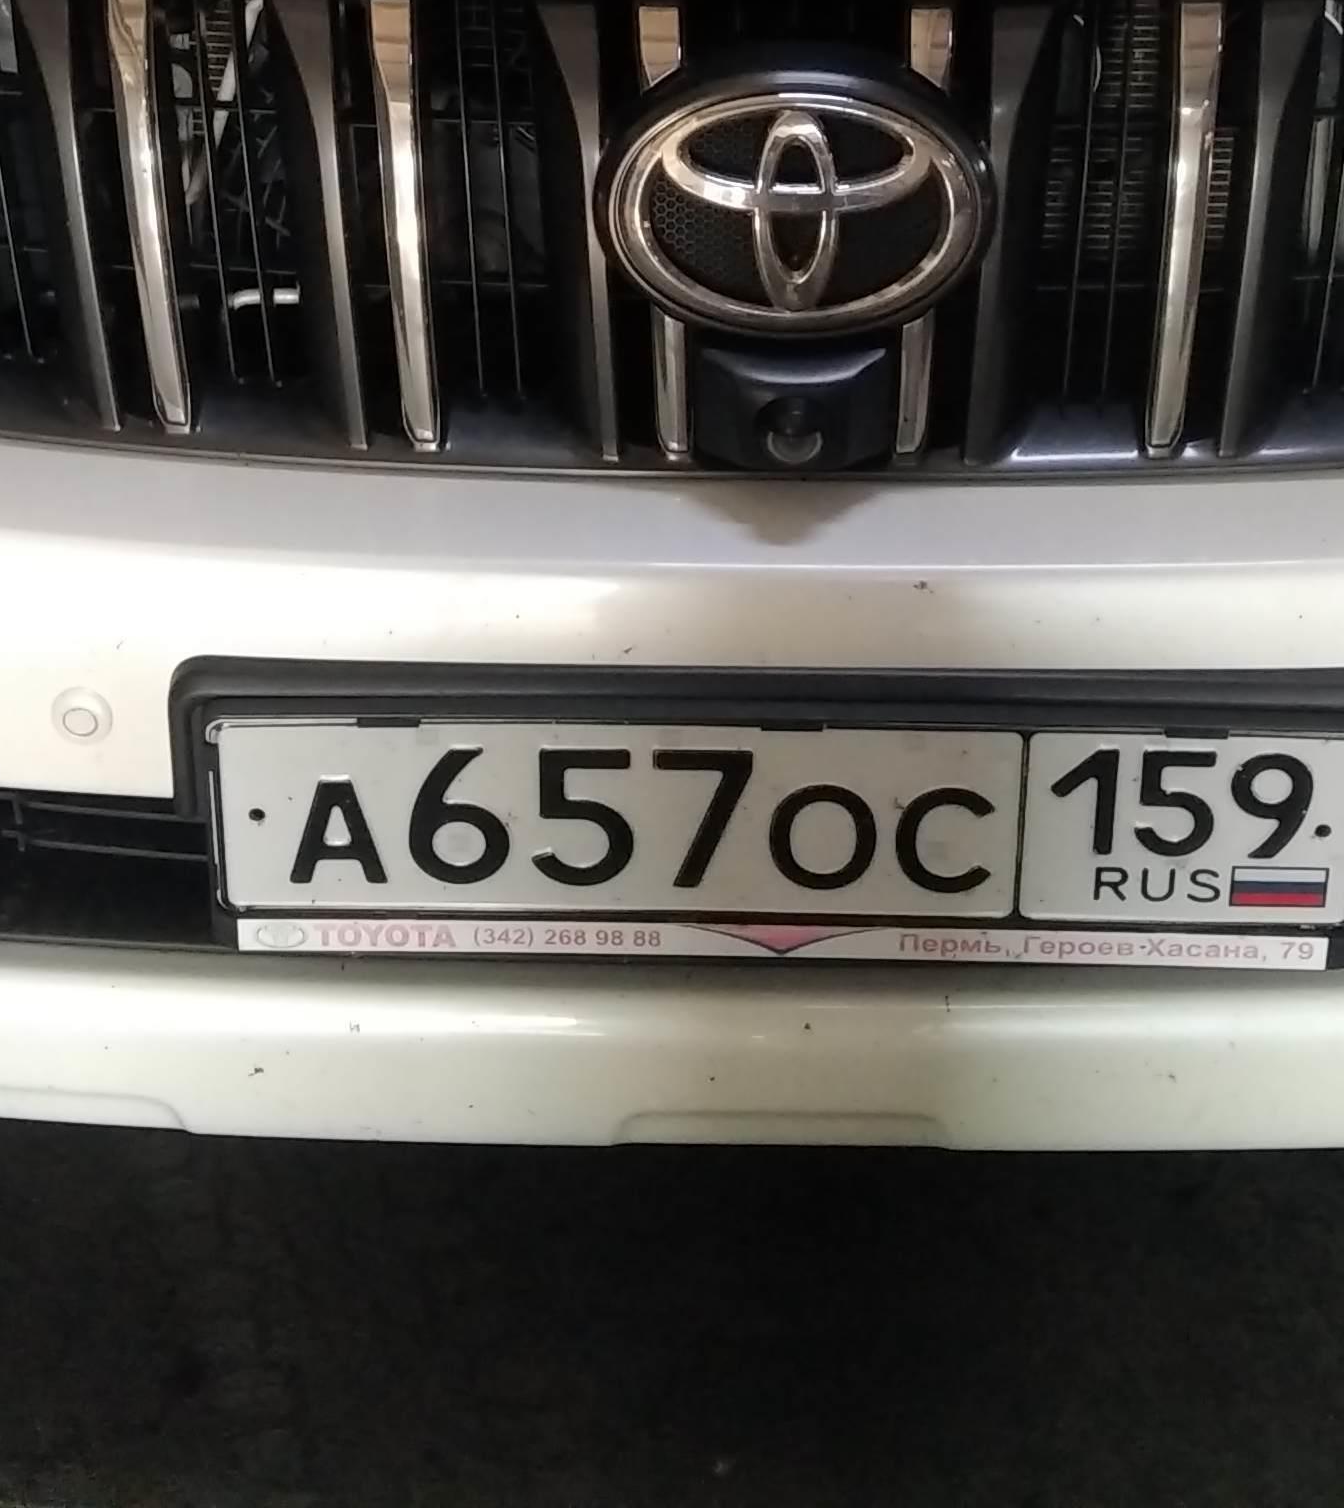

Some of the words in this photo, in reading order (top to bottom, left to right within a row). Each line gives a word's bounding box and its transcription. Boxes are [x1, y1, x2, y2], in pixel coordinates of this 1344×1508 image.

[1050, 749, 1314, 859] 159
[1092, 866, 1221, 902] RUS
[314, 924, 456, 948] TOYOTA
[473, 925, 534, 946] (342)
[544, 929, 587, 946] 268
[596, 930, 624, 946] 98
[633, 931, 662, 947] 88
[899, 932, 1011, 958] Пермь,
[1023, 936, 1267, 962] Героев-Хасана,
[1280, 941, 1315, 960] 79
